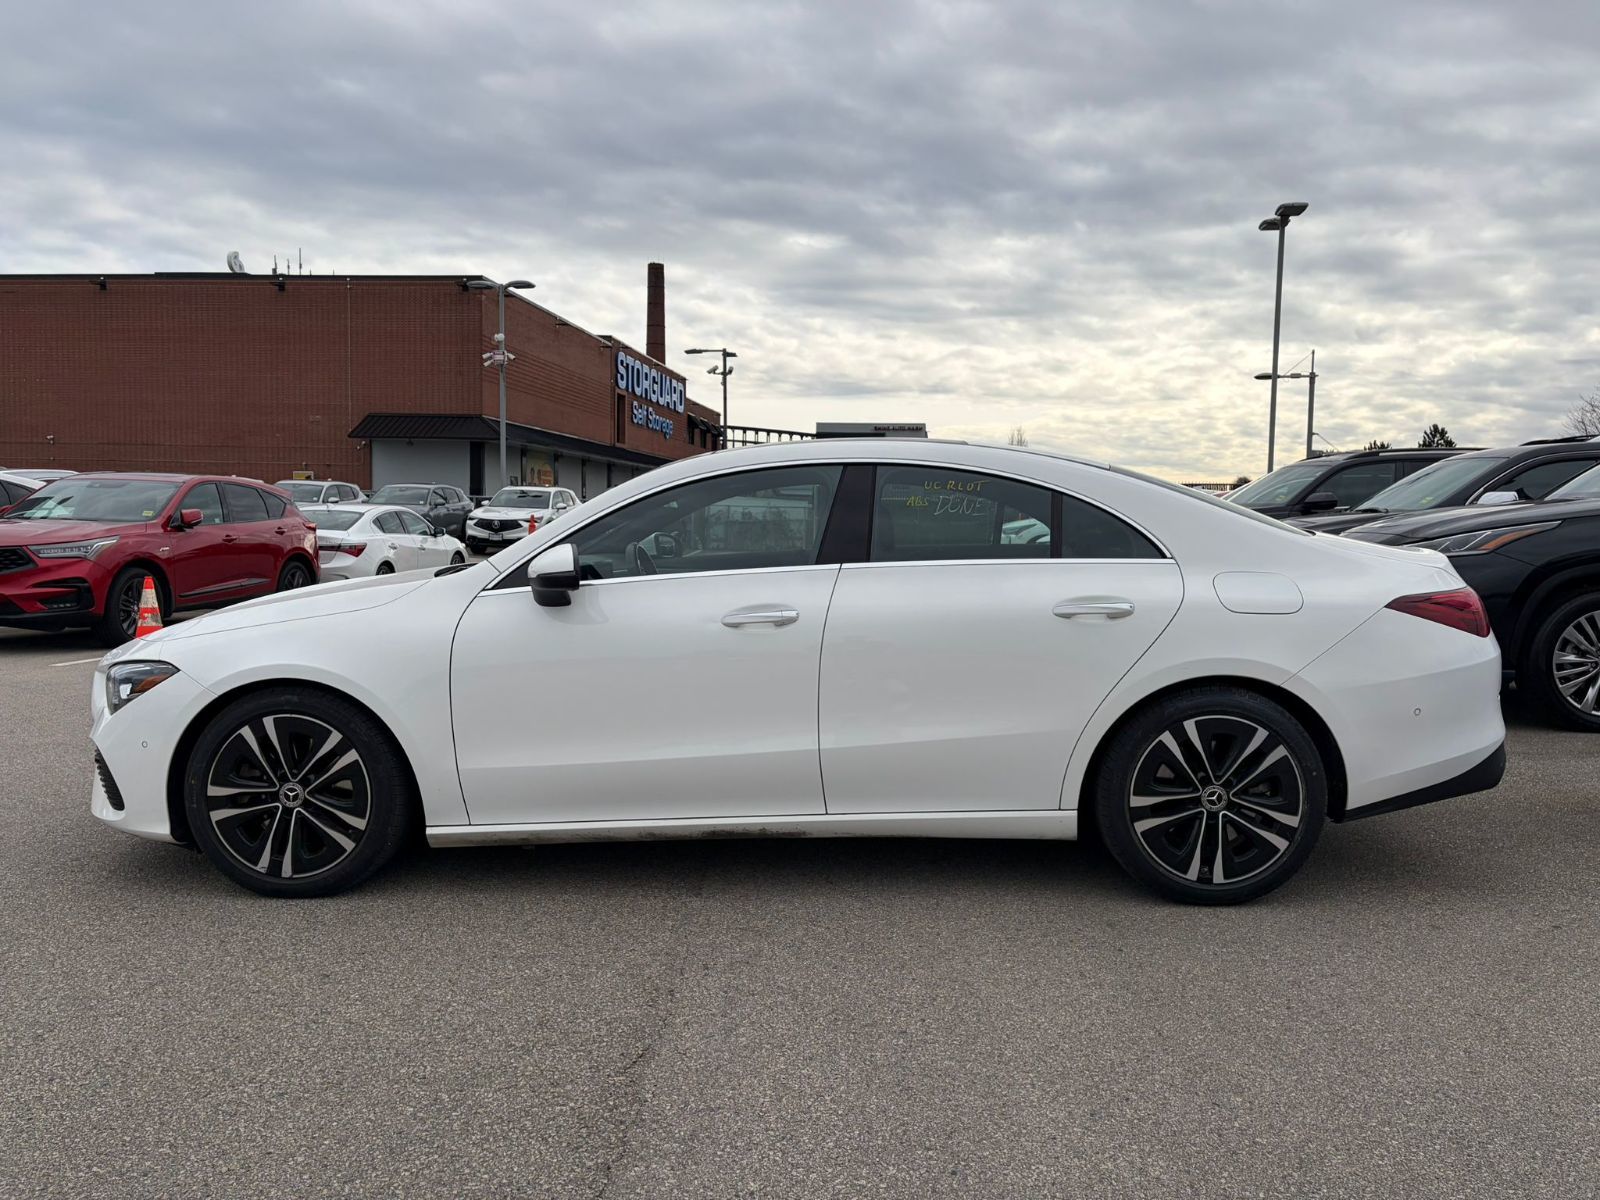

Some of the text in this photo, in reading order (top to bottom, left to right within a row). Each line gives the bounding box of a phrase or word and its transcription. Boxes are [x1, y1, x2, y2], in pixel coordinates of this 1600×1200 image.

[617, 351, 685, 413] STORGUARD
[632, 400, 673, 439] Self Storage
[934, 495, 985, 516] DONE
